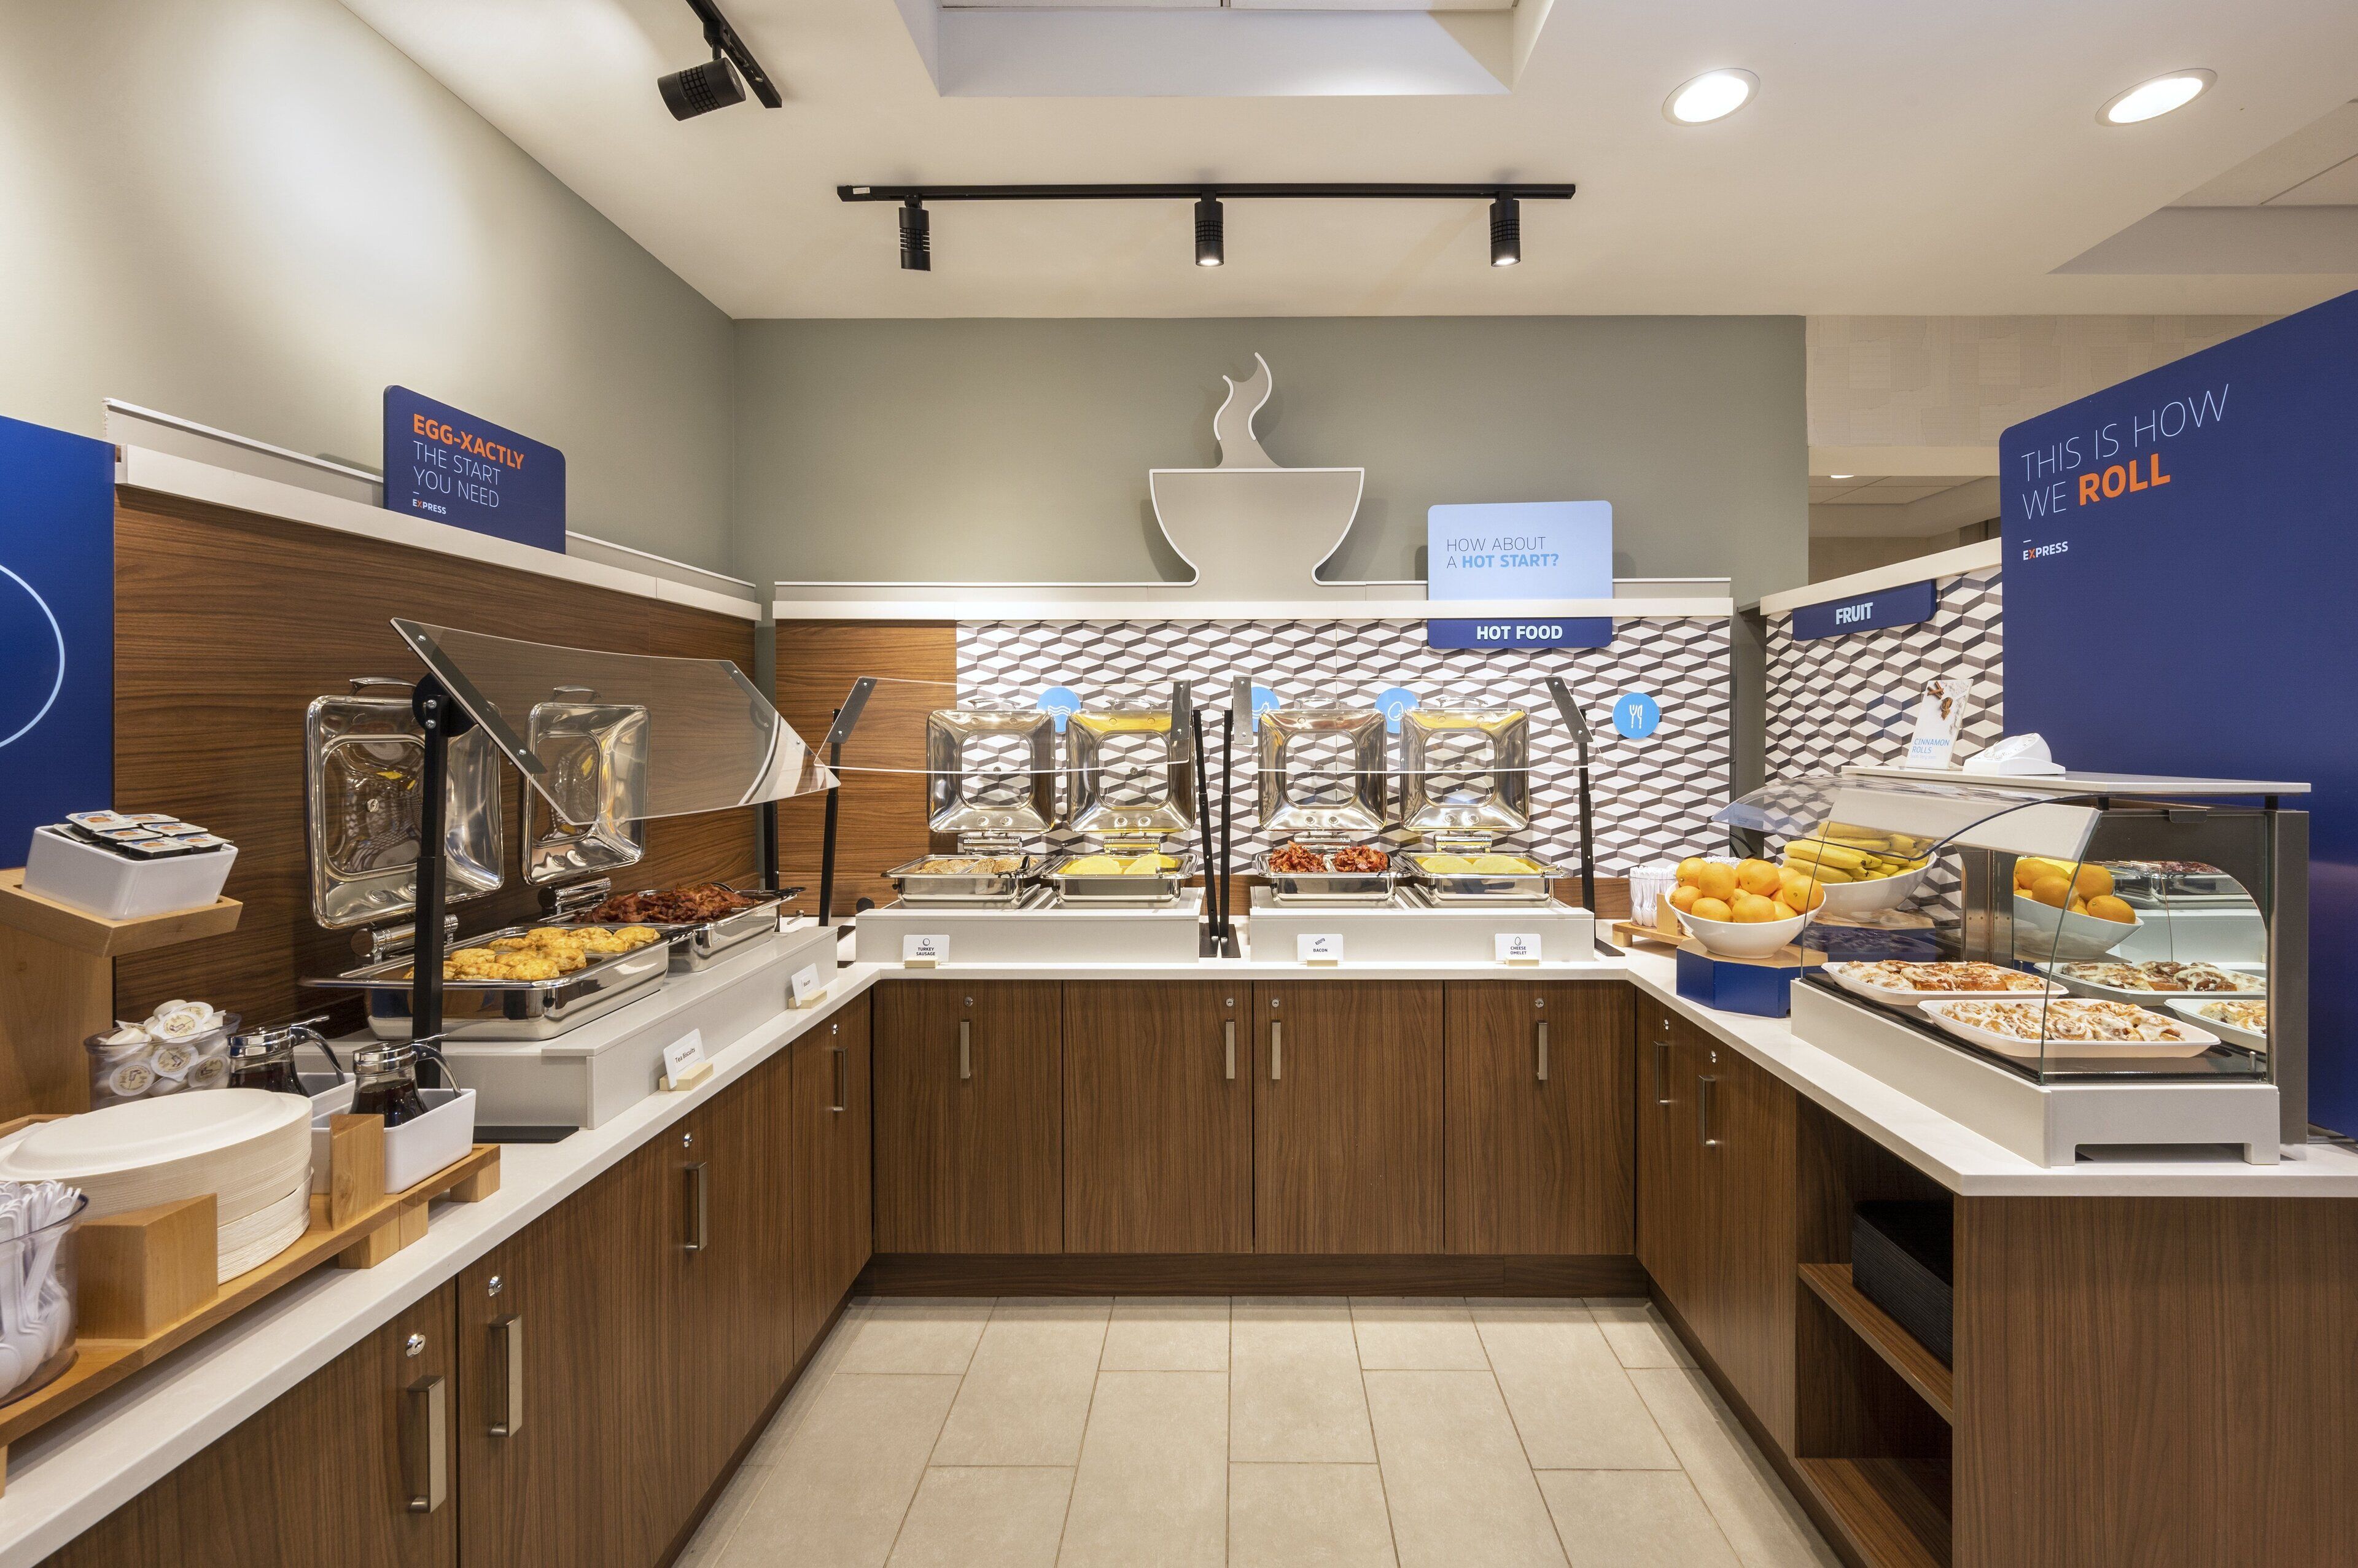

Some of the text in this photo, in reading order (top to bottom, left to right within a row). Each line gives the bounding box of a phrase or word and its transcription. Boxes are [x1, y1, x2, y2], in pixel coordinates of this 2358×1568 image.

[413, 413, 525, 470] EGG-XACTLY
[2020, 383, 2229, 482] THIS IS HOW
[413, 440, 501, 486] THE START
[413, 465, 499, 508] YOU NEED
[2022, 452, 2171, 520] WE ROLL
[413, 499, 446, 515] EXPRESS
[1447, 537, 1546, 552] HOW ABOUT
[2023, 541, 2069, 561] EXPRESS
[1446, 553, 1560, 569] A HOT START?
[1835, 602, 1874, 625] FRUIT
[1476, 625, 1563, 640] HOT FOOD
[1914, 738, 1950, 747] CINNAMON
[682, 1047, 696, 1059] Biscuits
